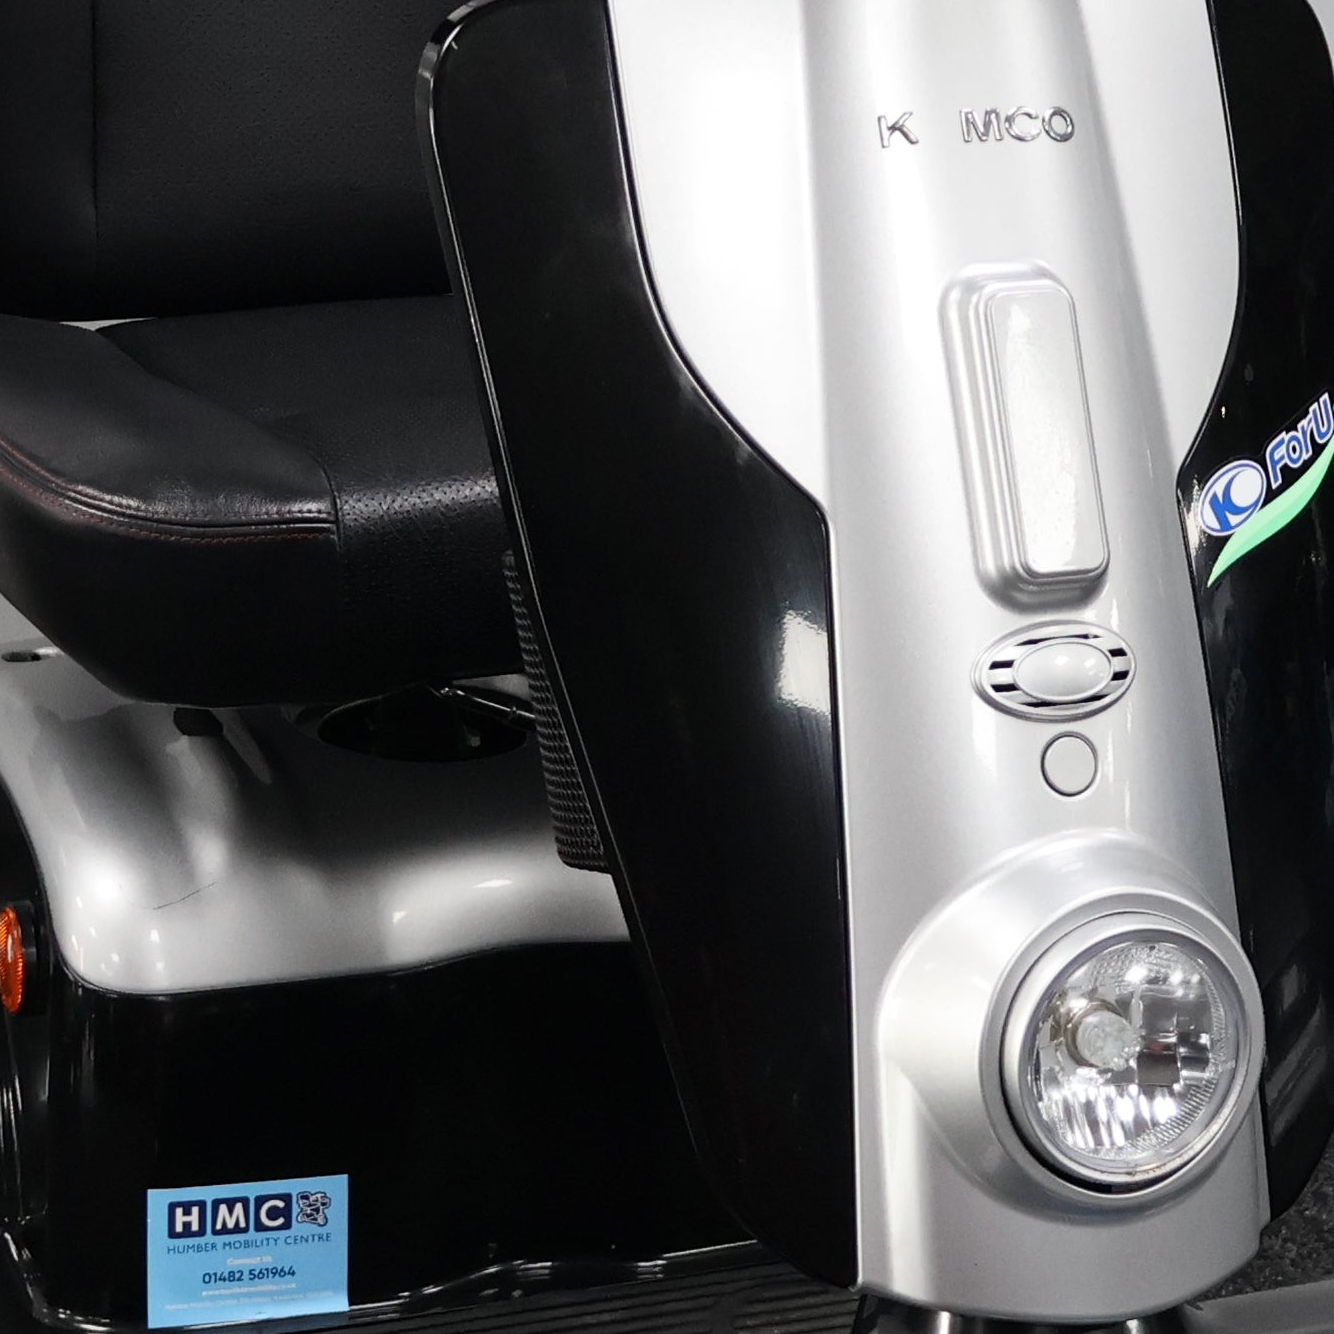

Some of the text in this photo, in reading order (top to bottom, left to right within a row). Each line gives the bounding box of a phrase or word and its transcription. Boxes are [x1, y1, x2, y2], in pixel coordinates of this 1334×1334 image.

[174, 1198, 286, 1234] HMC
[167, 1232, 332, 1255] HUMBER MOBILITY CENTRE
[202, 1265, 296, 1284] 01482 561964
